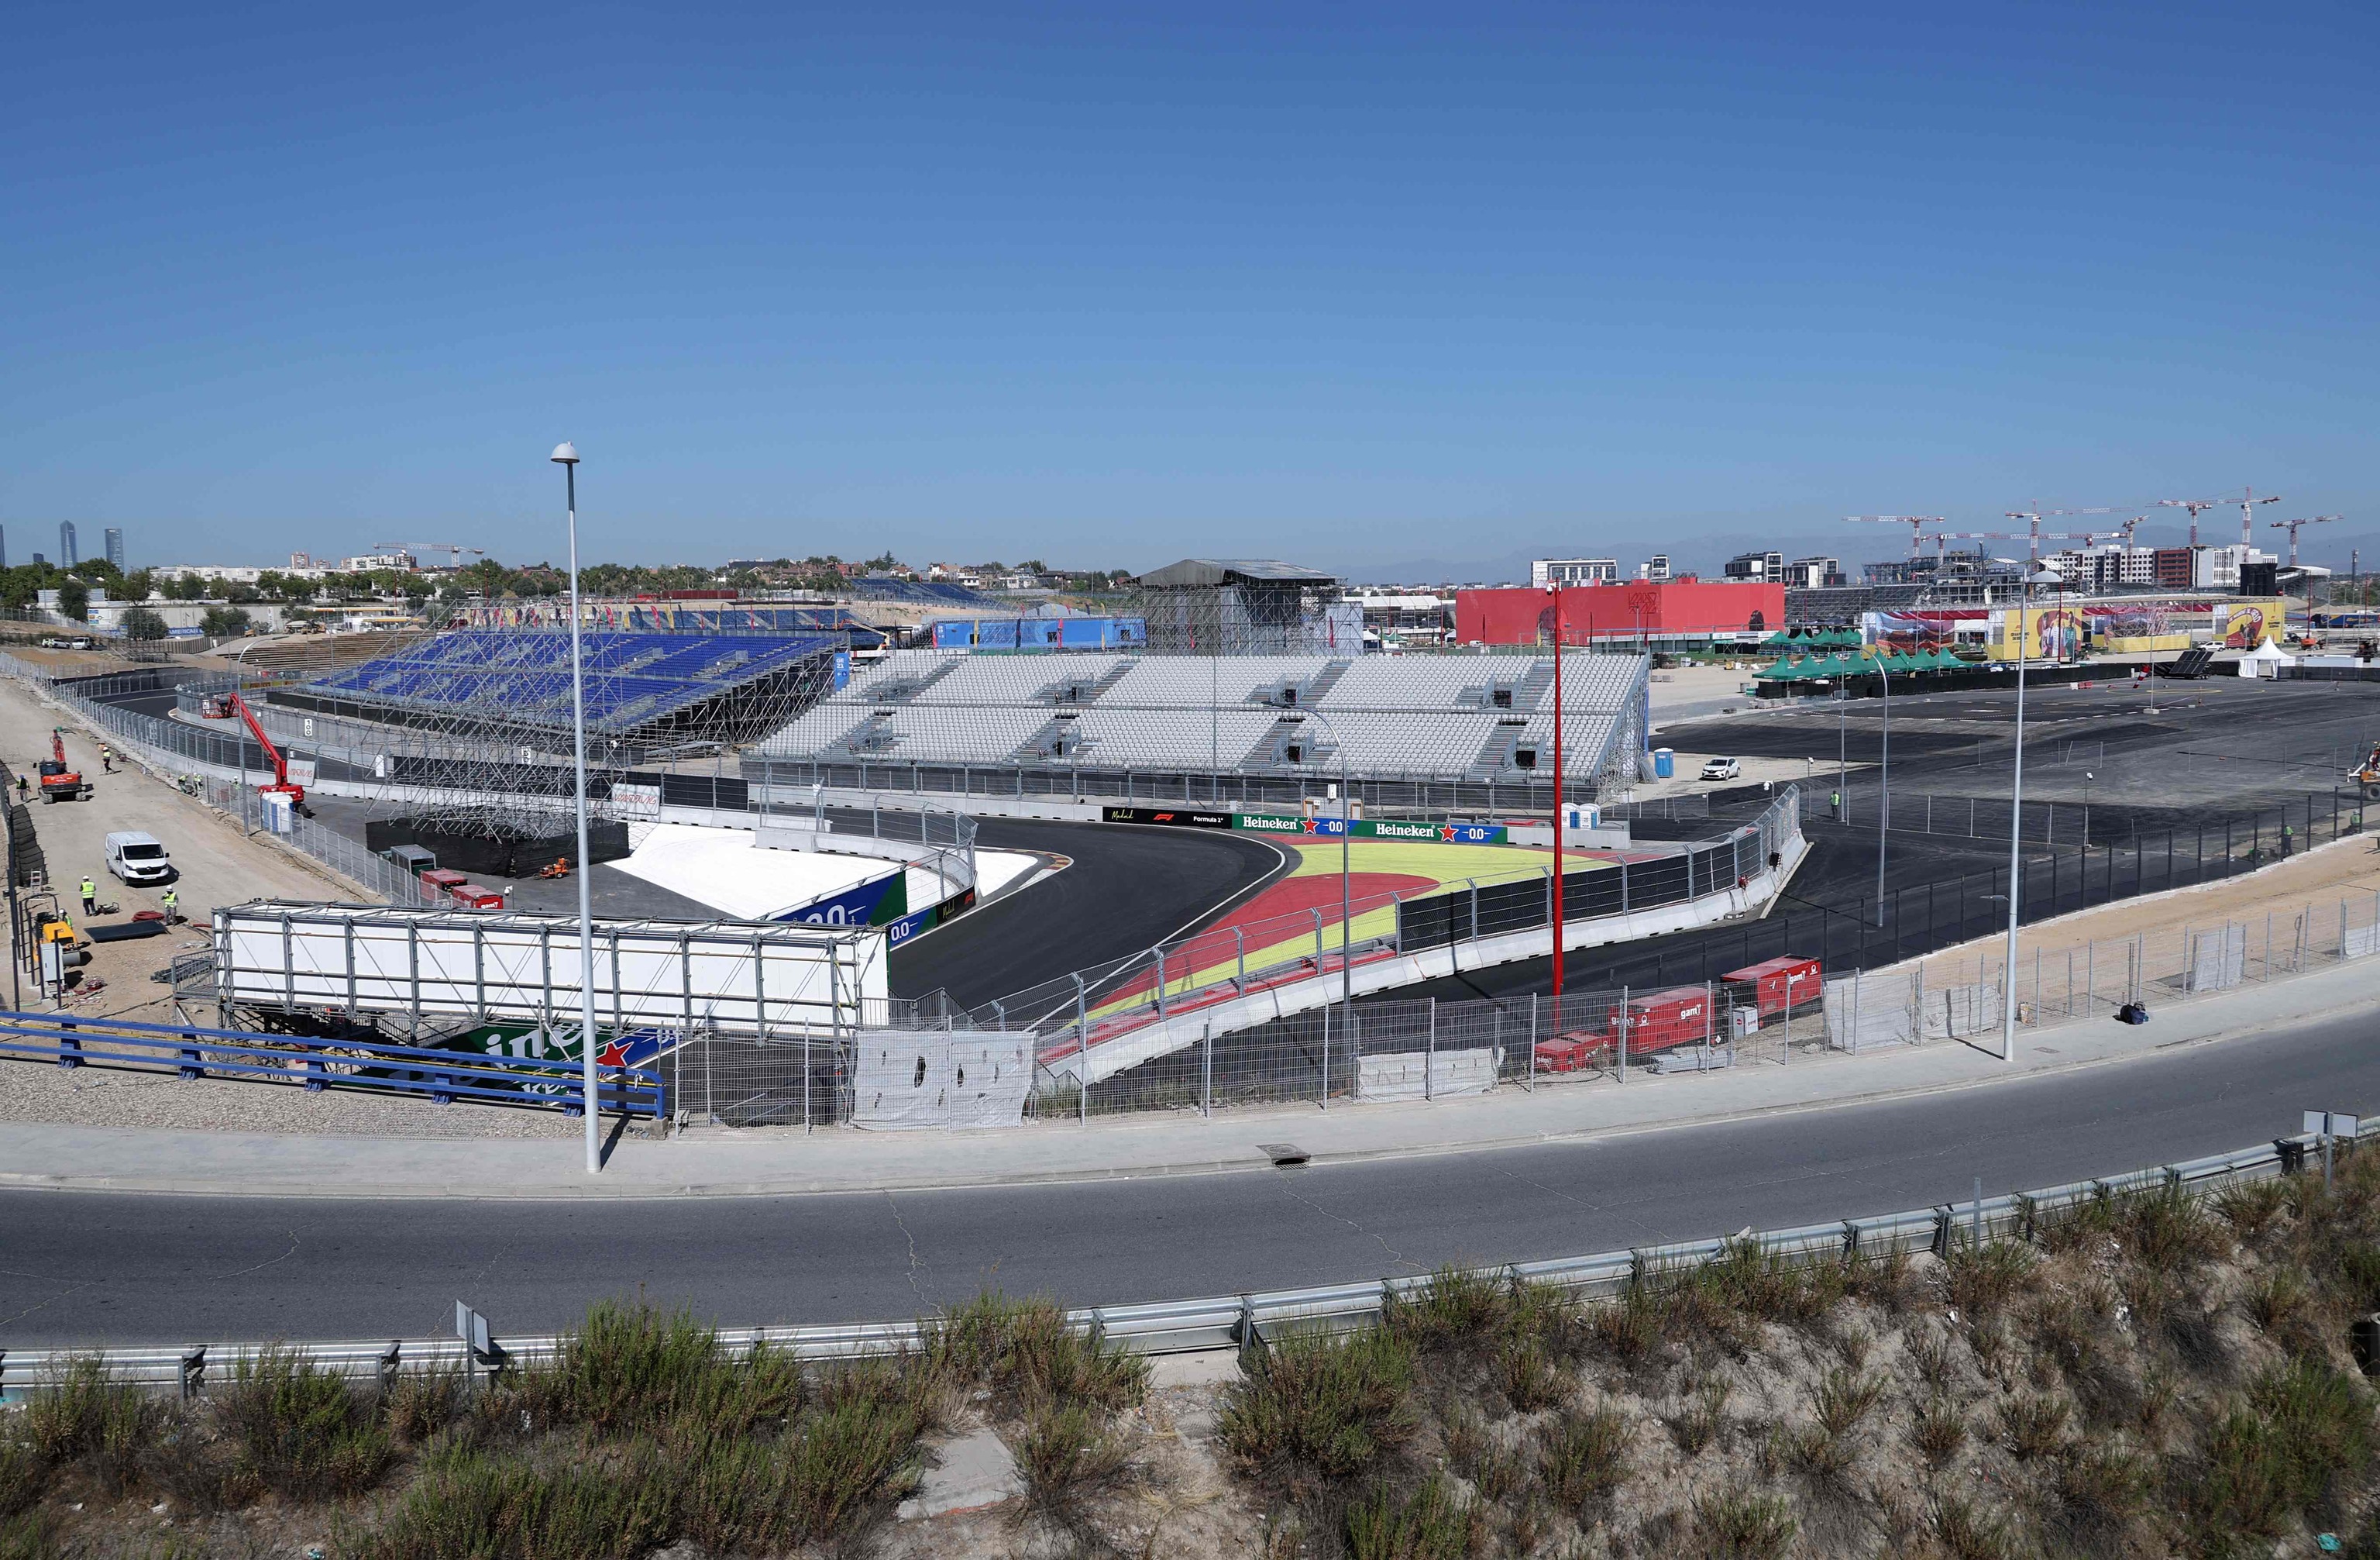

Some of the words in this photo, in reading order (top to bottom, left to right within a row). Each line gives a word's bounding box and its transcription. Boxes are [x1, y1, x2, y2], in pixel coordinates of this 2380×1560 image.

[1111, 808, 1134, 821] Madrid
[1243, 816, 1298, 830] Heineken
[1376, 823, 1435, 838] Heineken
